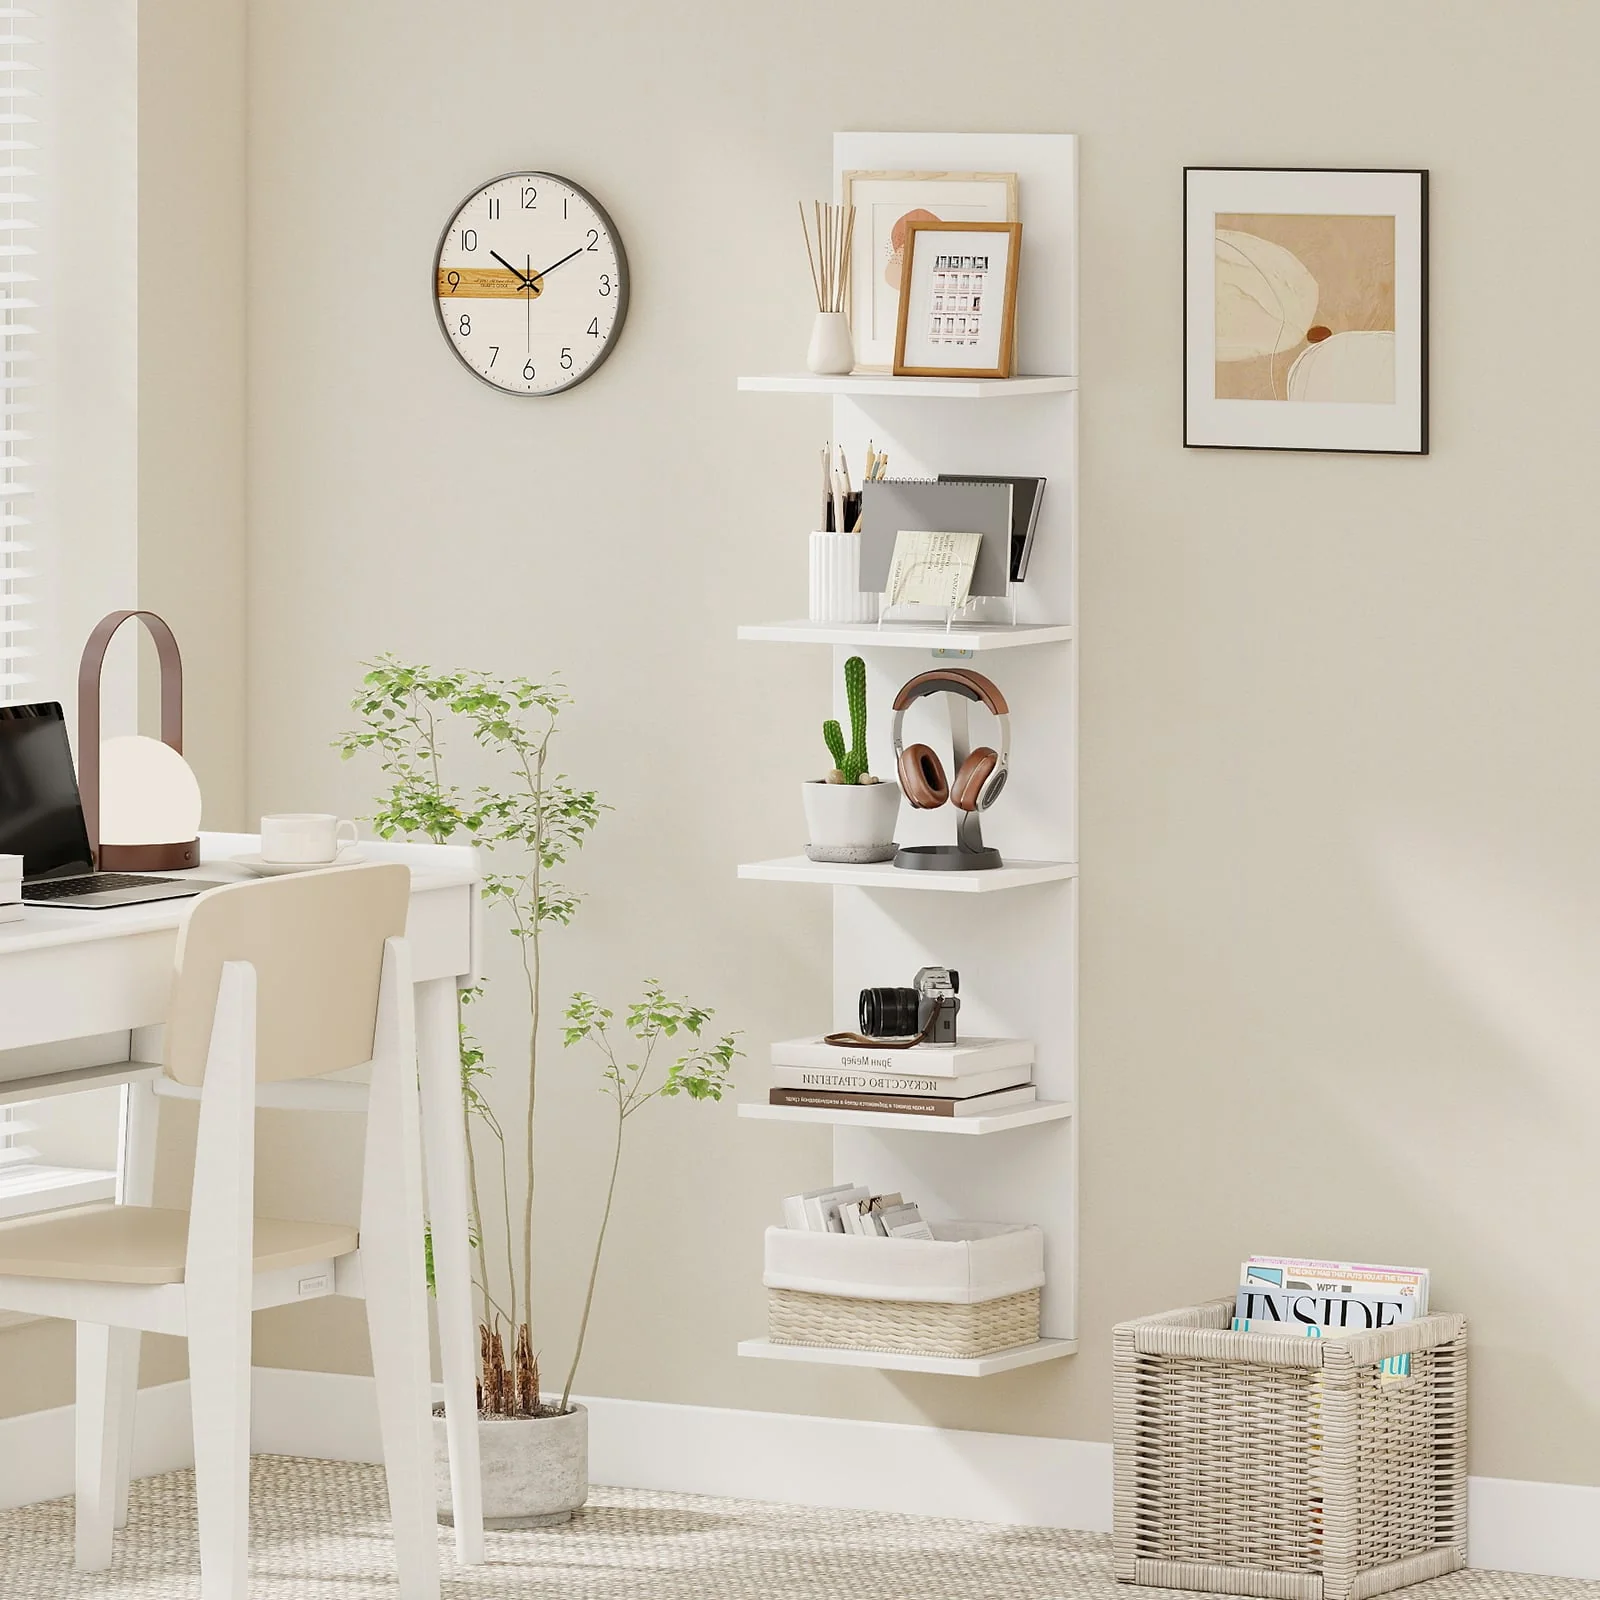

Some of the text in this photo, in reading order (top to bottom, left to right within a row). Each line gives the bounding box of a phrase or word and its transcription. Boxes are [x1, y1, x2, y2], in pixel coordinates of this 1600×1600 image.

[489, 198, 500, 220] 11
[521, 187, 537, 209] 12
[461, 229, 477, 252] 10
[586, 229, 598, 252] 2
[447, 271, 460, 293] 9
[598, 274, 611, 296] 3
[459, 314, 471, 336] 8
[586, 317, 599, 338] 4
[488, 346, 500, 368] 7
[559, 347, 573, 369] 5
[522, 358, 536, 380] 6
[1316, 1283, 1337, 1292] WPT
[1242, 1292, 1403, 1329] INSIDE
